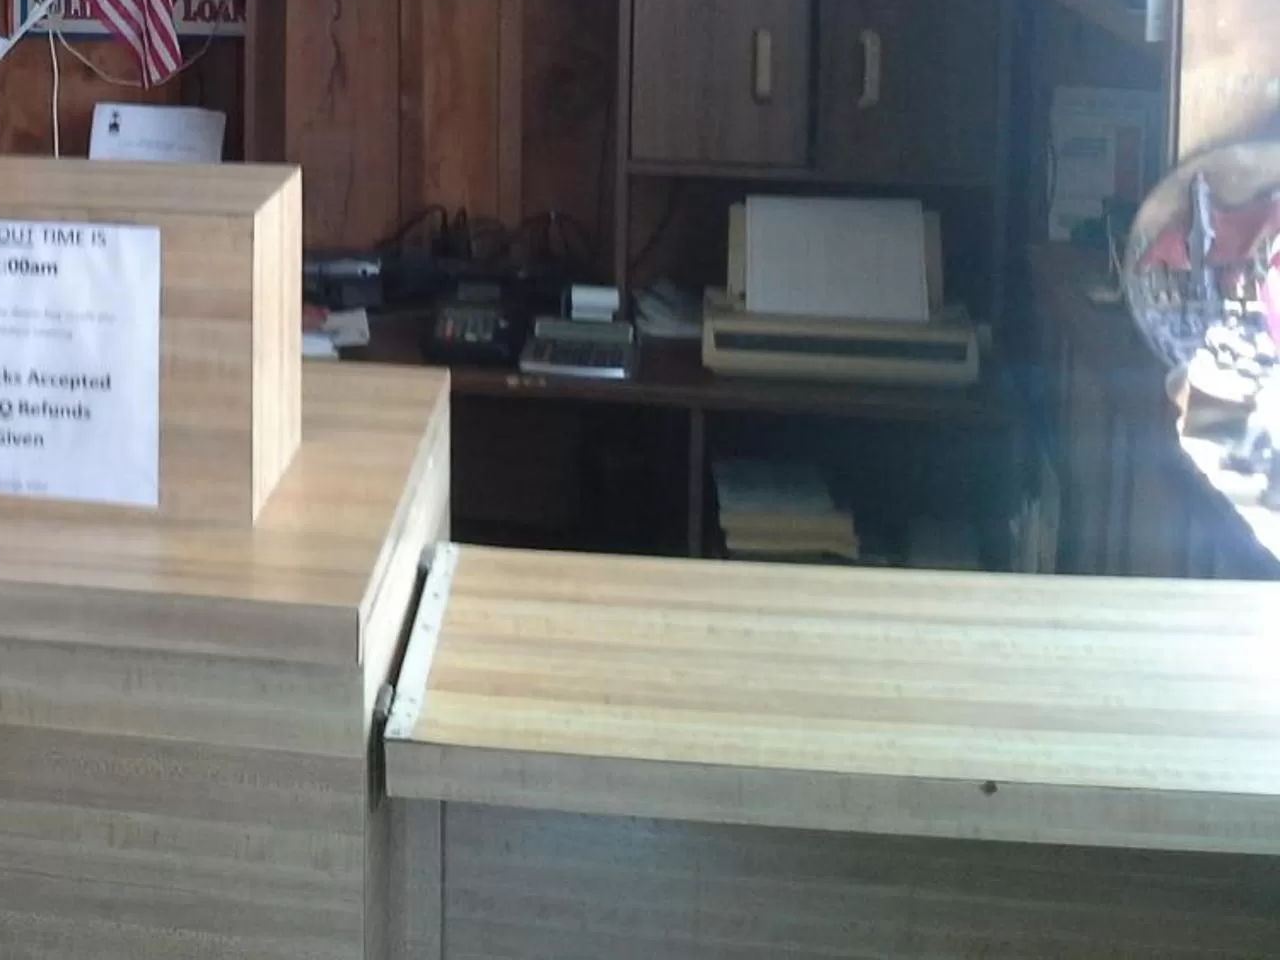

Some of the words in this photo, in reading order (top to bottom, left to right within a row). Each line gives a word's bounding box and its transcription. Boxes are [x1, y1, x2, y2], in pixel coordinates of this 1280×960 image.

[42, 226, 84, 246] TIME
[91, 228, 108, 248] IS
[28, 368, 112, 392] Accepted
[18, 400, 92, 420] Refunds
